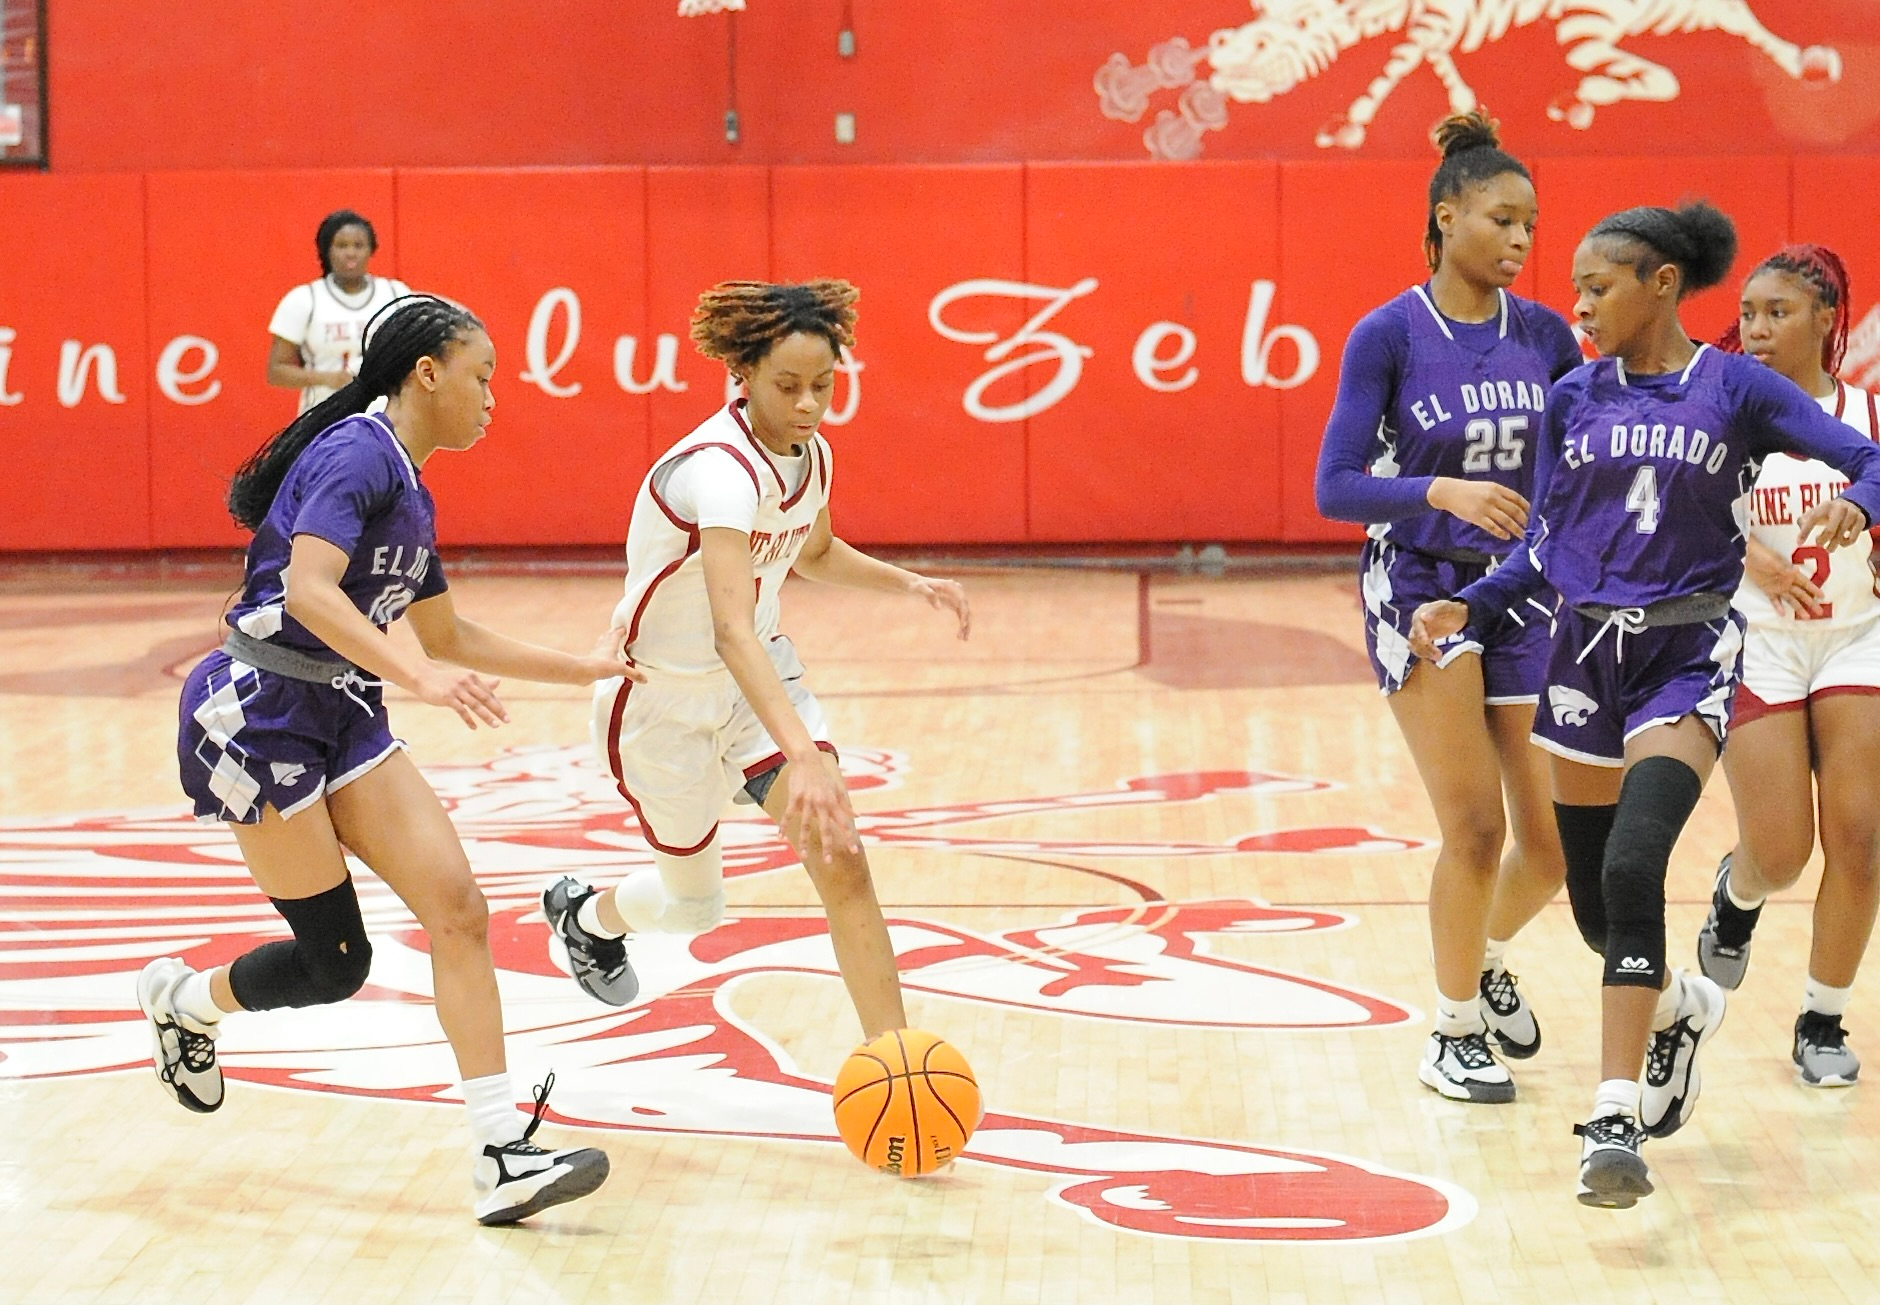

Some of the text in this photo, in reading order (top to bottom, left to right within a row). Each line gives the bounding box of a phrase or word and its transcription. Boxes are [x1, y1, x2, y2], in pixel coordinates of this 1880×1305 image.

[0, 325, 223, 408] ine
[928, 278, 1320, 422] Zeb
[1410, 380, 1545, 431] EL DORAD
[1462, 415, 1529, 473] 25
[1565, 423, 1728, 475] EL DORADO
[1625, 465, 1661, 535] 4
[371, 545, 404, 576] EL
[1791, 545, 1833, 620] 2
